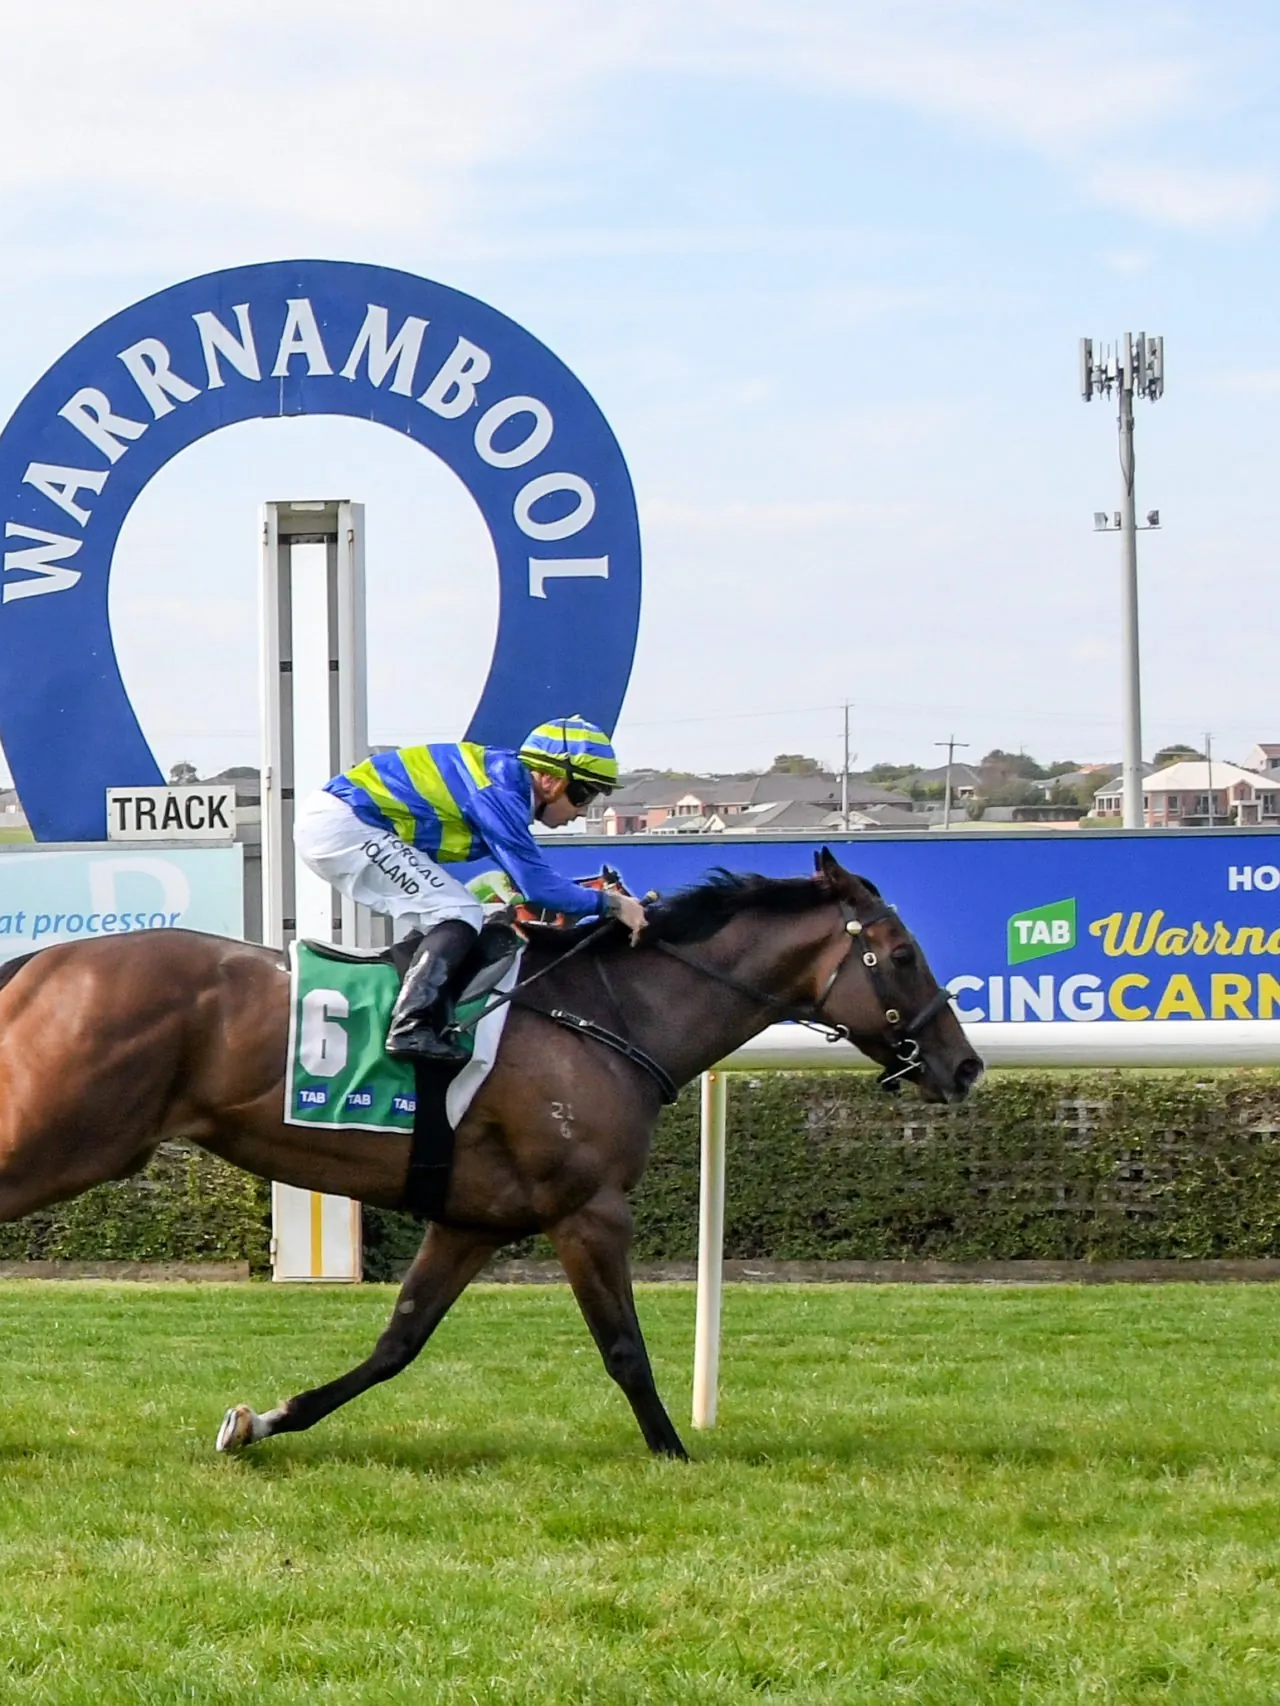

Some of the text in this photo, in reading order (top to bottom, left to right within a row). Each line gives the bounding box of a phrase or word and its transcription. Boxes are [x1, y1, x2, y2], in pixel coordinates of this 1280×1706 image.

[2, 298, 609, 604] WARRNAMBOOL
[112, 794, 229, 831] TRACK
[32, 911, 182, 940] processor
[1013, 920, 1070, 944] TAB
[299, 988, 350, 1077] 6
[299, 1090, 326, 1104] TAB
[348, 1093, 372, 1106] TAB
[394, 1097, 417, 1112] TAB
